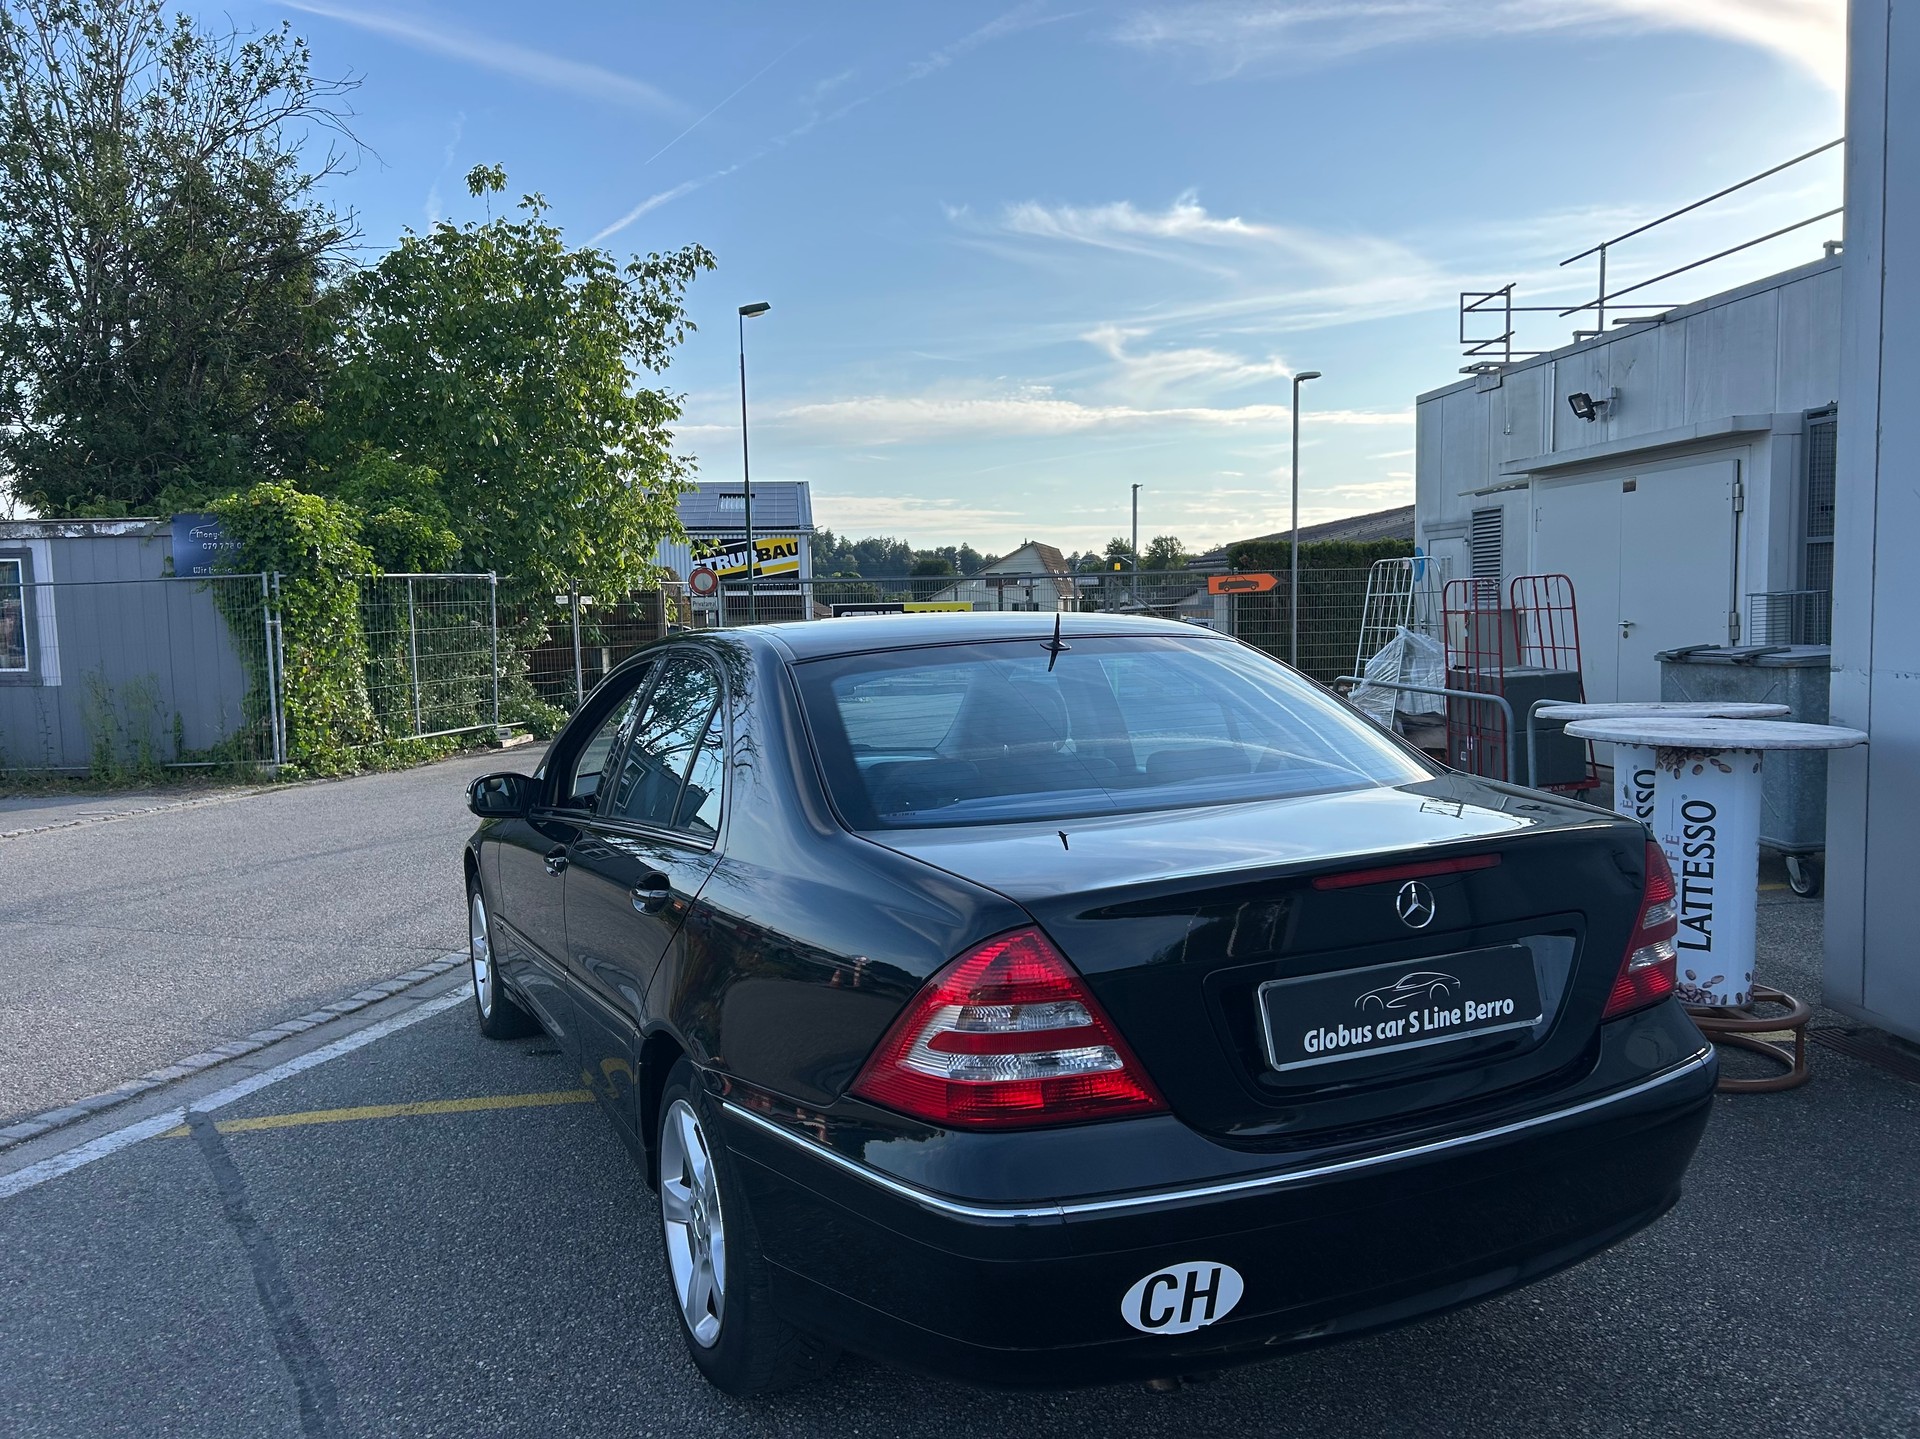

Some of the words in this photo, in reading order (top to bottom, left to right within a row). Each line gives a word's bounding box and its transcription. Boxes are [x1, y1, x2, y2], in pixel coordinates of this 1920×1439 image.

[1676, 800, 1717, 953] LATTESSO
[1303, 1024, 1373, 1053] Globus
[1376, 1018, 1405, 1039] car
[1408, 1013, 1420, 1034] S
[1424, 1006, 1461, 1031] Line
[1465, 998, 1515, 1023] Berro
[1140, 1267, 1222, 1328] CH
